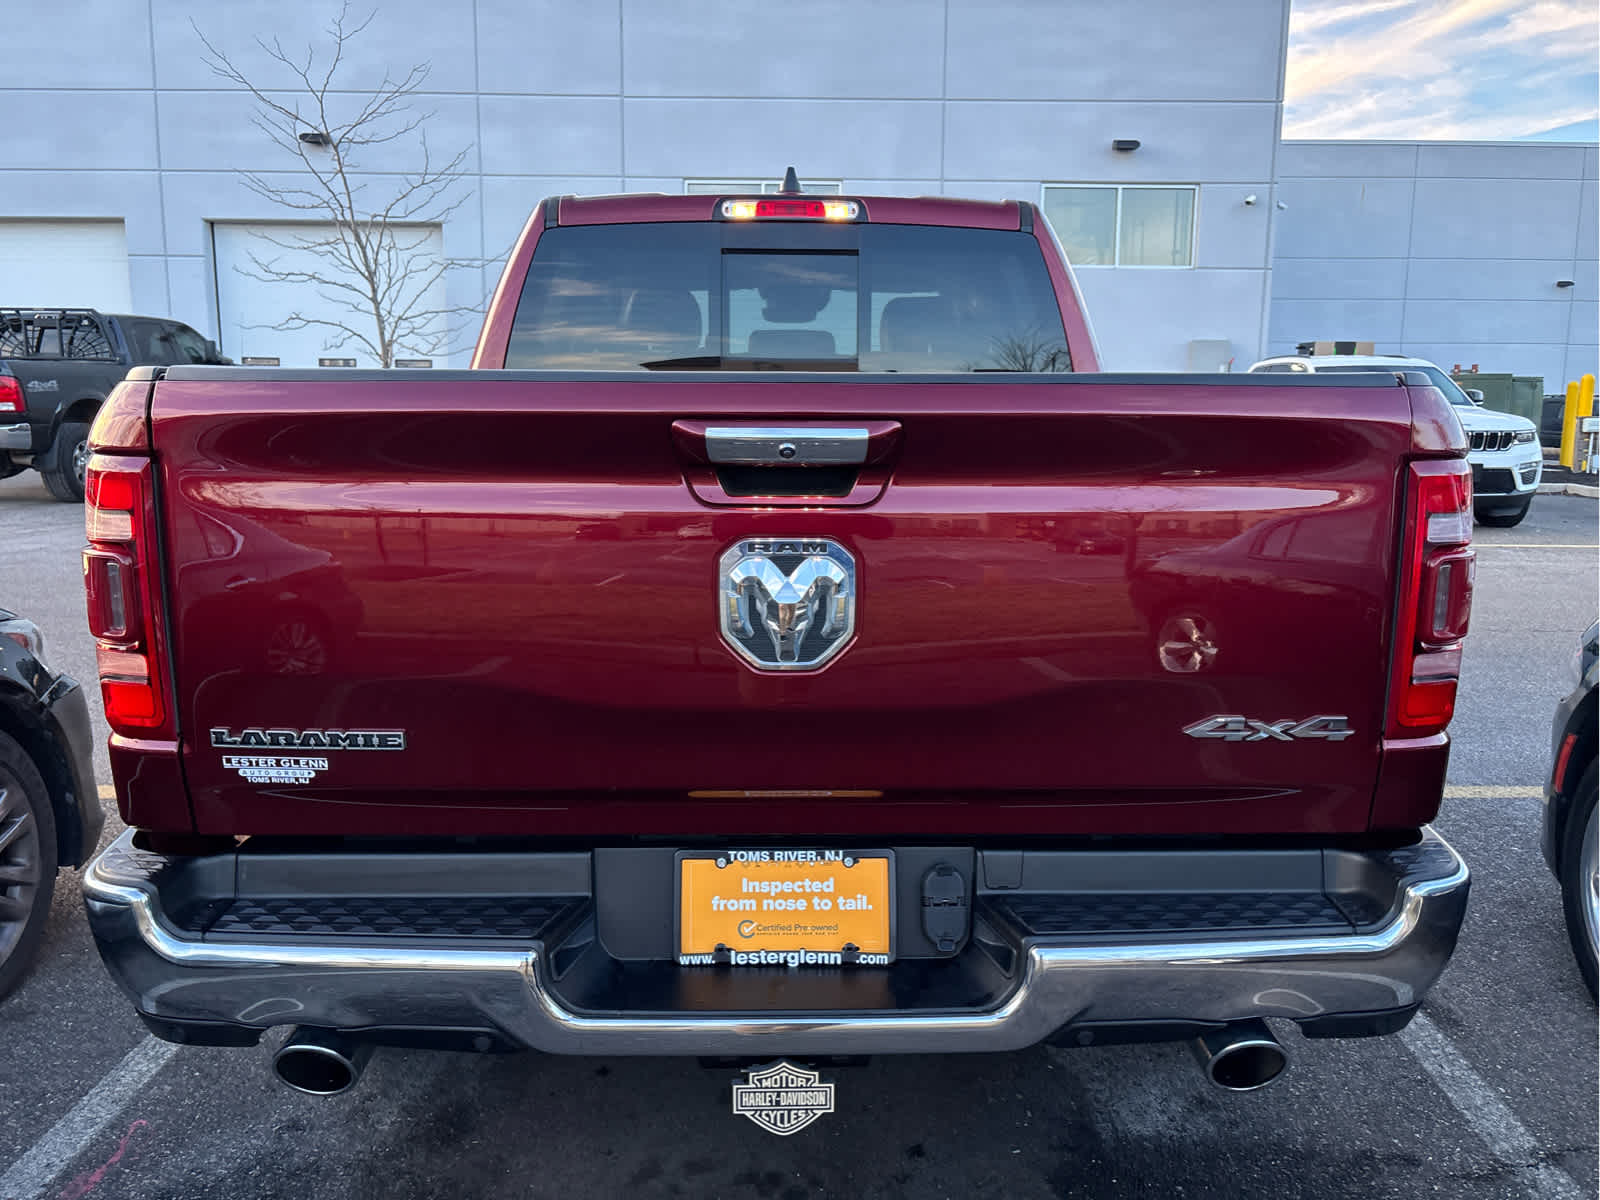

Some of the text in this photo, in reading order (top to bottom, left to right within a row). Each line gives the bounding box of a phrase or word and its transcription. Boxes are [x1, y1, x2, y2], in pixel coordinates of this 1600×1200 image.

[747, 543, 829, 554] RAM
[1183, 715, 1355, 741] 4x4
[210, 727, 406, 750] LARAMIE
[223, 757, 328, 769] LESTER GLENN
[728, 851, 770, 861] TOMS
[825, 850, 844, 861] NJ
[742, 877, 834, 896] Inspected
[711, 894, 873, 911] from nose to tail.
[756, 923, 793, 932] Certified
[730, 949, 842, 967] lesterglenn
[761, 1071, 807, 1088] MOTOR
[742, 1091, 826, 1106] HARLEY-DAVIDSON
[761, 1110, 807, 1128] CYCLES
